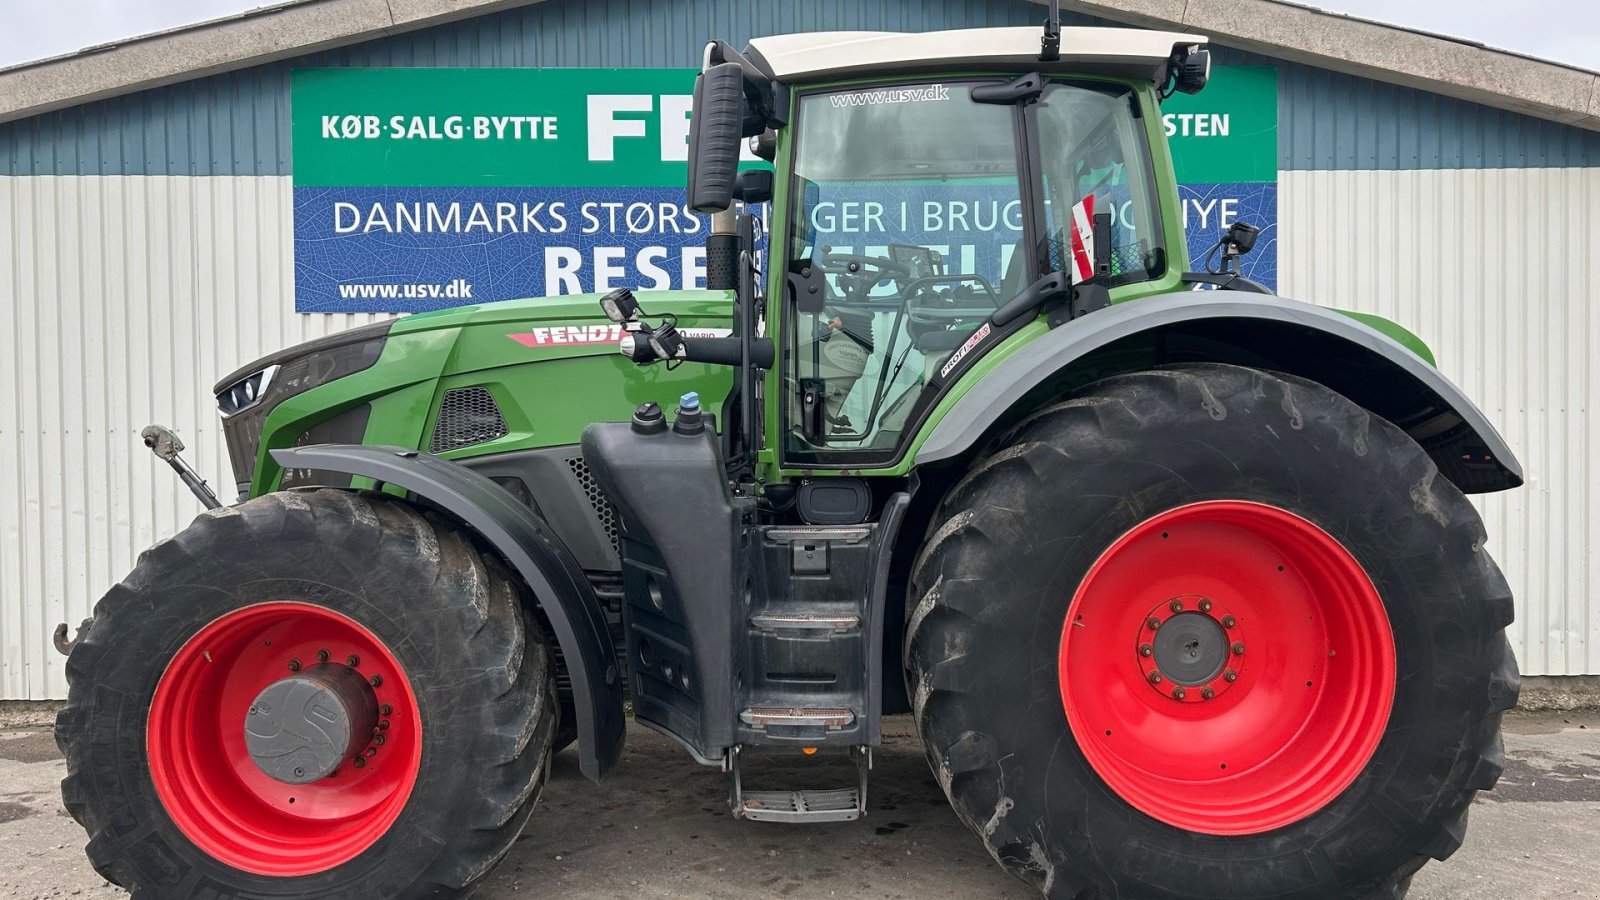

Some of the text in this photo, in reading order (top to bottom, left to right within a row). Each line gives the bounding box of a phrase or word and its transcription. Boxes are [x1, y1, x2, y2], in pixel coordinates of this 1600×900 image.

[829, 84, 950, 107] www.usv.dk
[333, 201, 568, 234] DANMARKS
[580, 201, 745, 234] STØRS
[900, 201, 908, 232] I
[338, 279, 473, 299] www.usv.dk
[532, 324, 623, 344] FENDT
